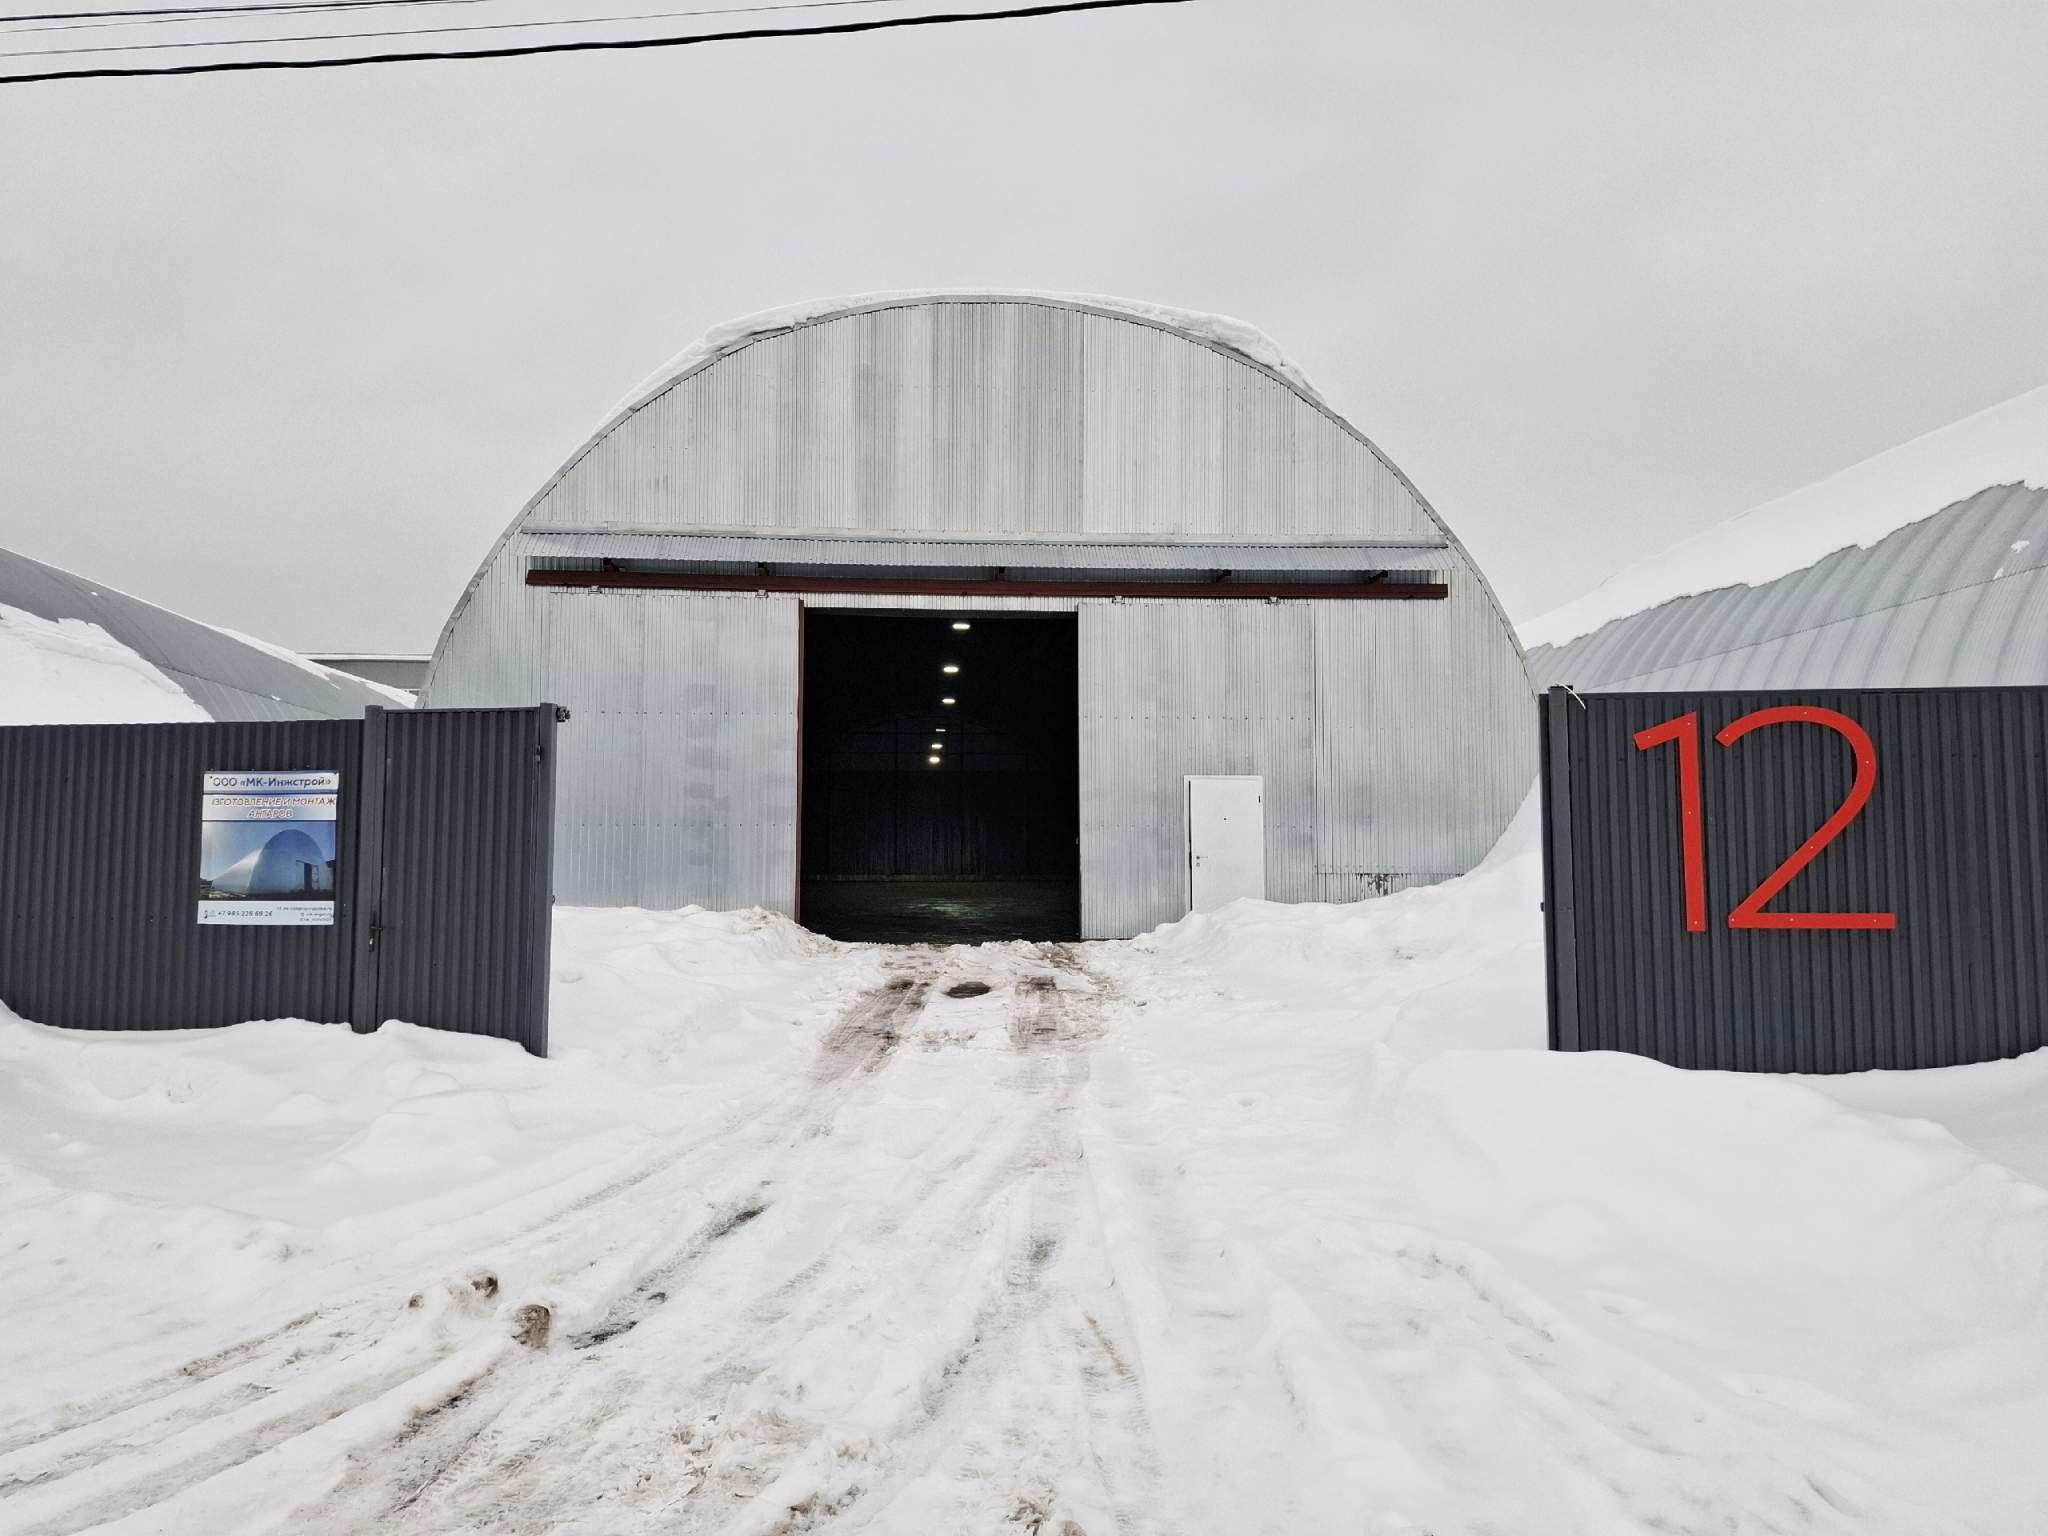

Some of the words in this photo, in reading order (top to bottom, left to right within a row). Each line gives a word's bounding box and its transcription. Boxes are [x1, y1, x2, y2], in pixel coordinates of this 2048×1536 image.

[213, 777, 237, 787] ООО
[240, 776, 331, 788] «МК-Инжстрой»
[292, 797, 336, 806] МОНТАЖ
[1633, 705, 1896, 932] 12
